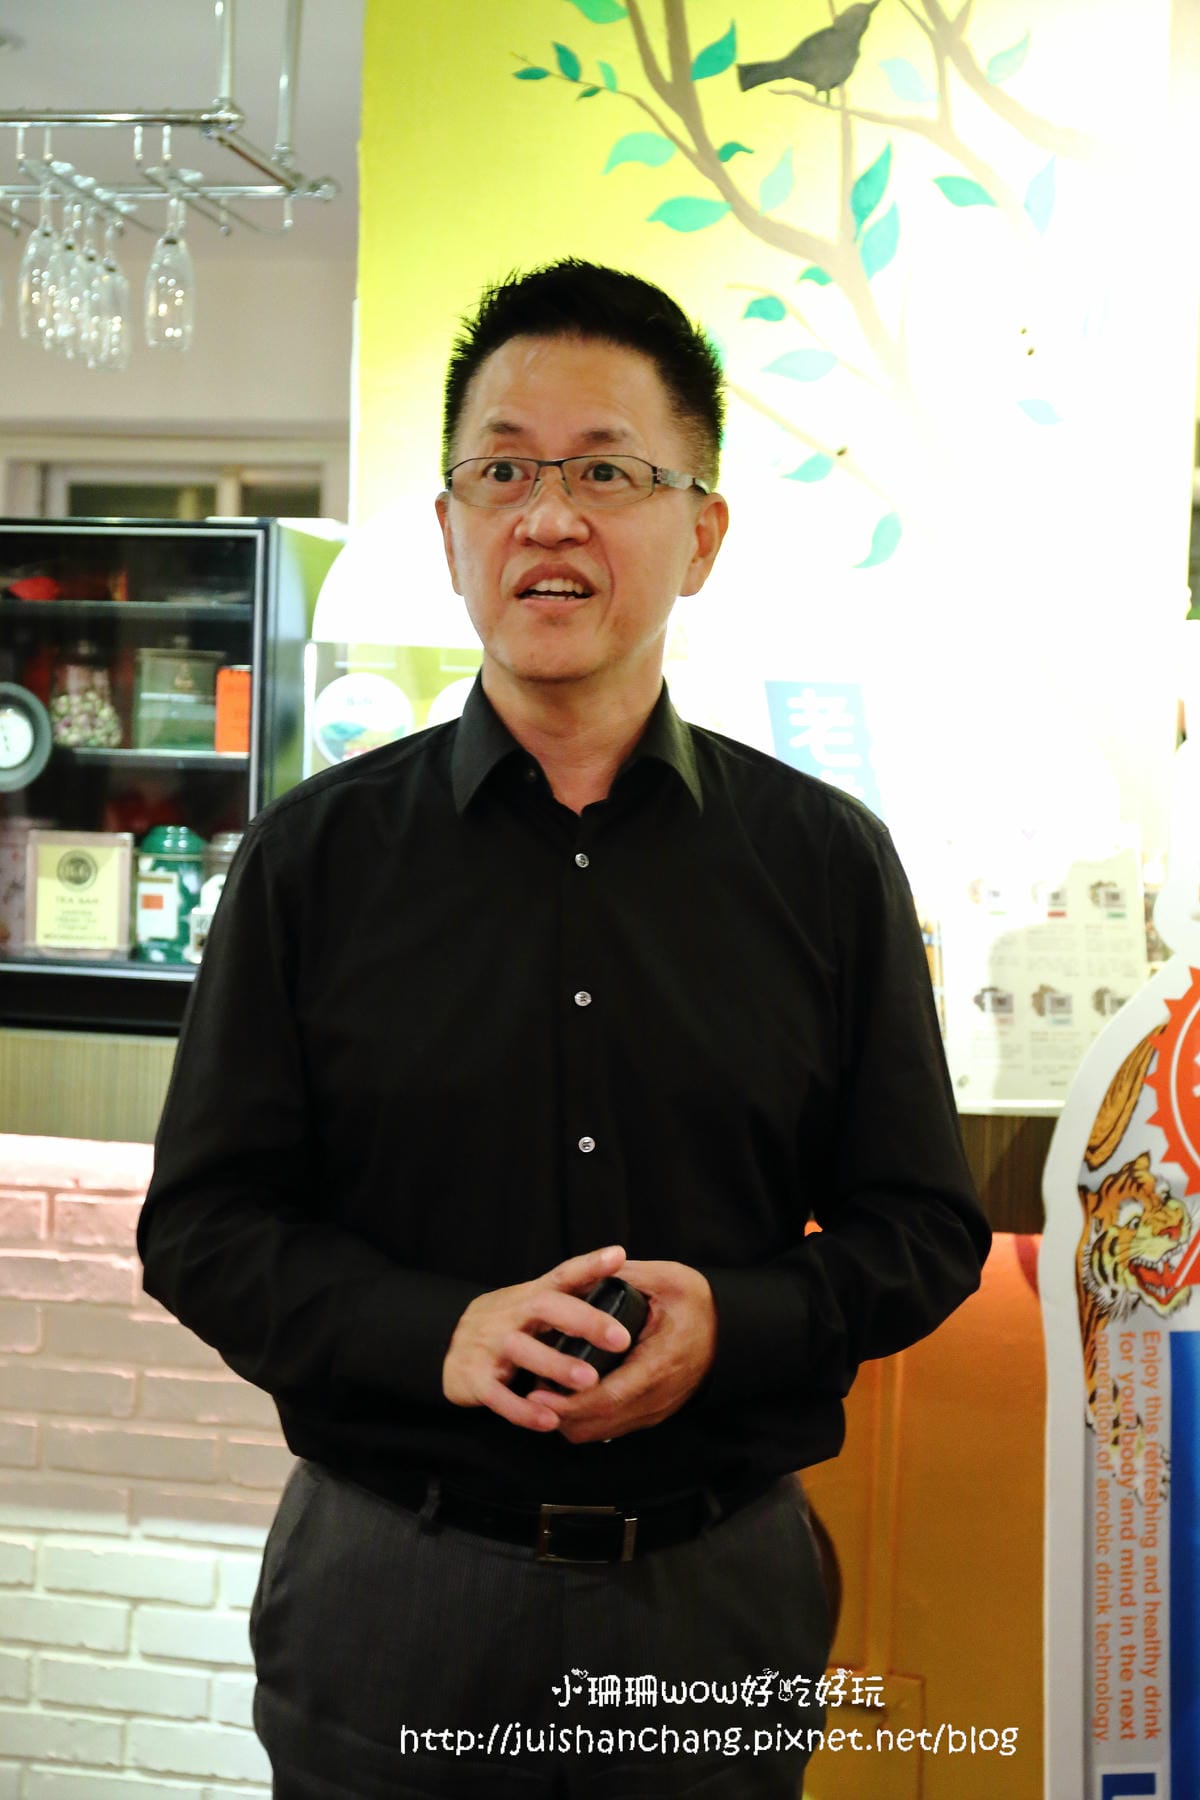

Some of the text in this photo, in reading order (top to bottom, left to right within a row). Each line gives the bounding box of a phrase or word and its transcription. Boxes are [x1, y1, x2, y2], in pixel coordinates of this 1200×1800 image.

[1094, 1331, 1114, 1444] generation
[1096, 1451, 1114, 1471] of
[1095, 1478, 1114, 1555] aerobic
[1117, 1331, 1138, 1740] for your body and mind in the next
[1139, 1330, 1163, 1740] Enjoy this refreshing and healthy drink
[1095, 1562, 1113, 1615] drink
